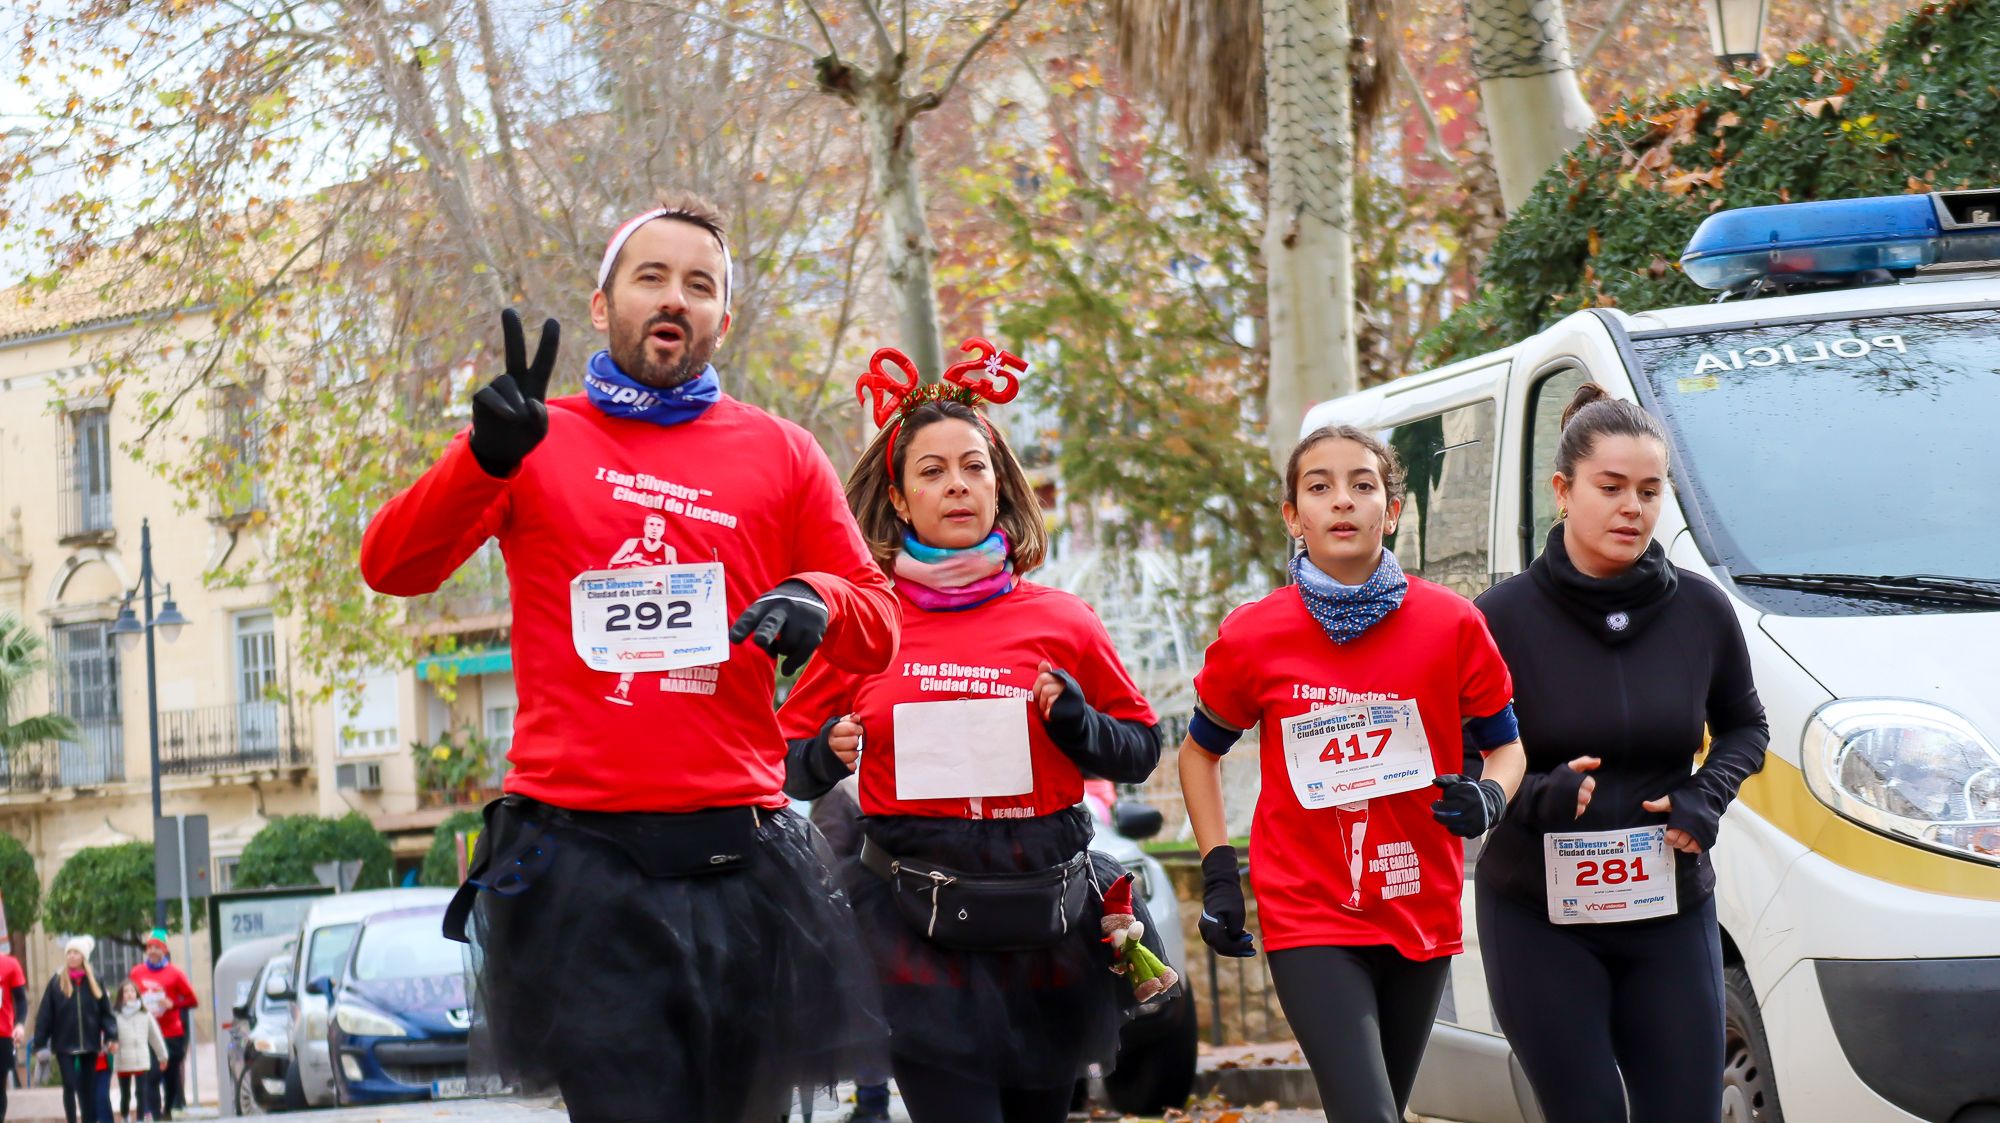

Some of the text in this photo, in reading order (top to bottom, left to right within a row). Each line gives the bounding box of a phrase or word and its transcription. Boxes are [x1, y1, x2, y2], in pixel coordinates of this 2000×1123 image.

[595, 467, 606, 480] I
[605, 469, 635, 488] San
[635, 473, 699, 501] Silvestre
[612, 486, 738, 529] Ciudad de Lucena
[588, 582, 604, 590] San
[606, 580, 644, 589] Silvestre
[588, 588, 662, 599] Ciudad de Lucena
[606, 600, 692, 632] 292
[902, 663, 911, 676] I
[911, 662, 938, 676] San
[939, 663, 1000, 680] Silvestre
[660, 678, 717, 695] MARJALIZO
[920, 677, 1035, 702] Ciudad de Lucena
[1293, 684, 1300, 699] I
[1301, 685, 1327, 700] San
[1328, 686, 1387, 702] Silvestre
[1297, 724, 1312, 732] San
[1313, 715, 1348, 728] Silvestre
[1297, 721, 1366, 739] Ciudad de Lucena
[1319, 728, 1392, 765] 417
[1383, 769, 1419, 781] enerplus
[1558, 841, 1573, 849] San
[1574, 840, 1608, 848] Silvestre
[1558, 847, 1624, 857] Ciudad de Lucena
[1369, 853, 1419, 873] JOSE CARLOS
[1576, 857, 1650, 886] 281
[1385, 867, 1420, 885] HURTADO
[1381, 881, 1420, 900] MARJALIZO
[1634, 895, 1664, 905] enerplus
[232, 914, 263, 932] 25N
